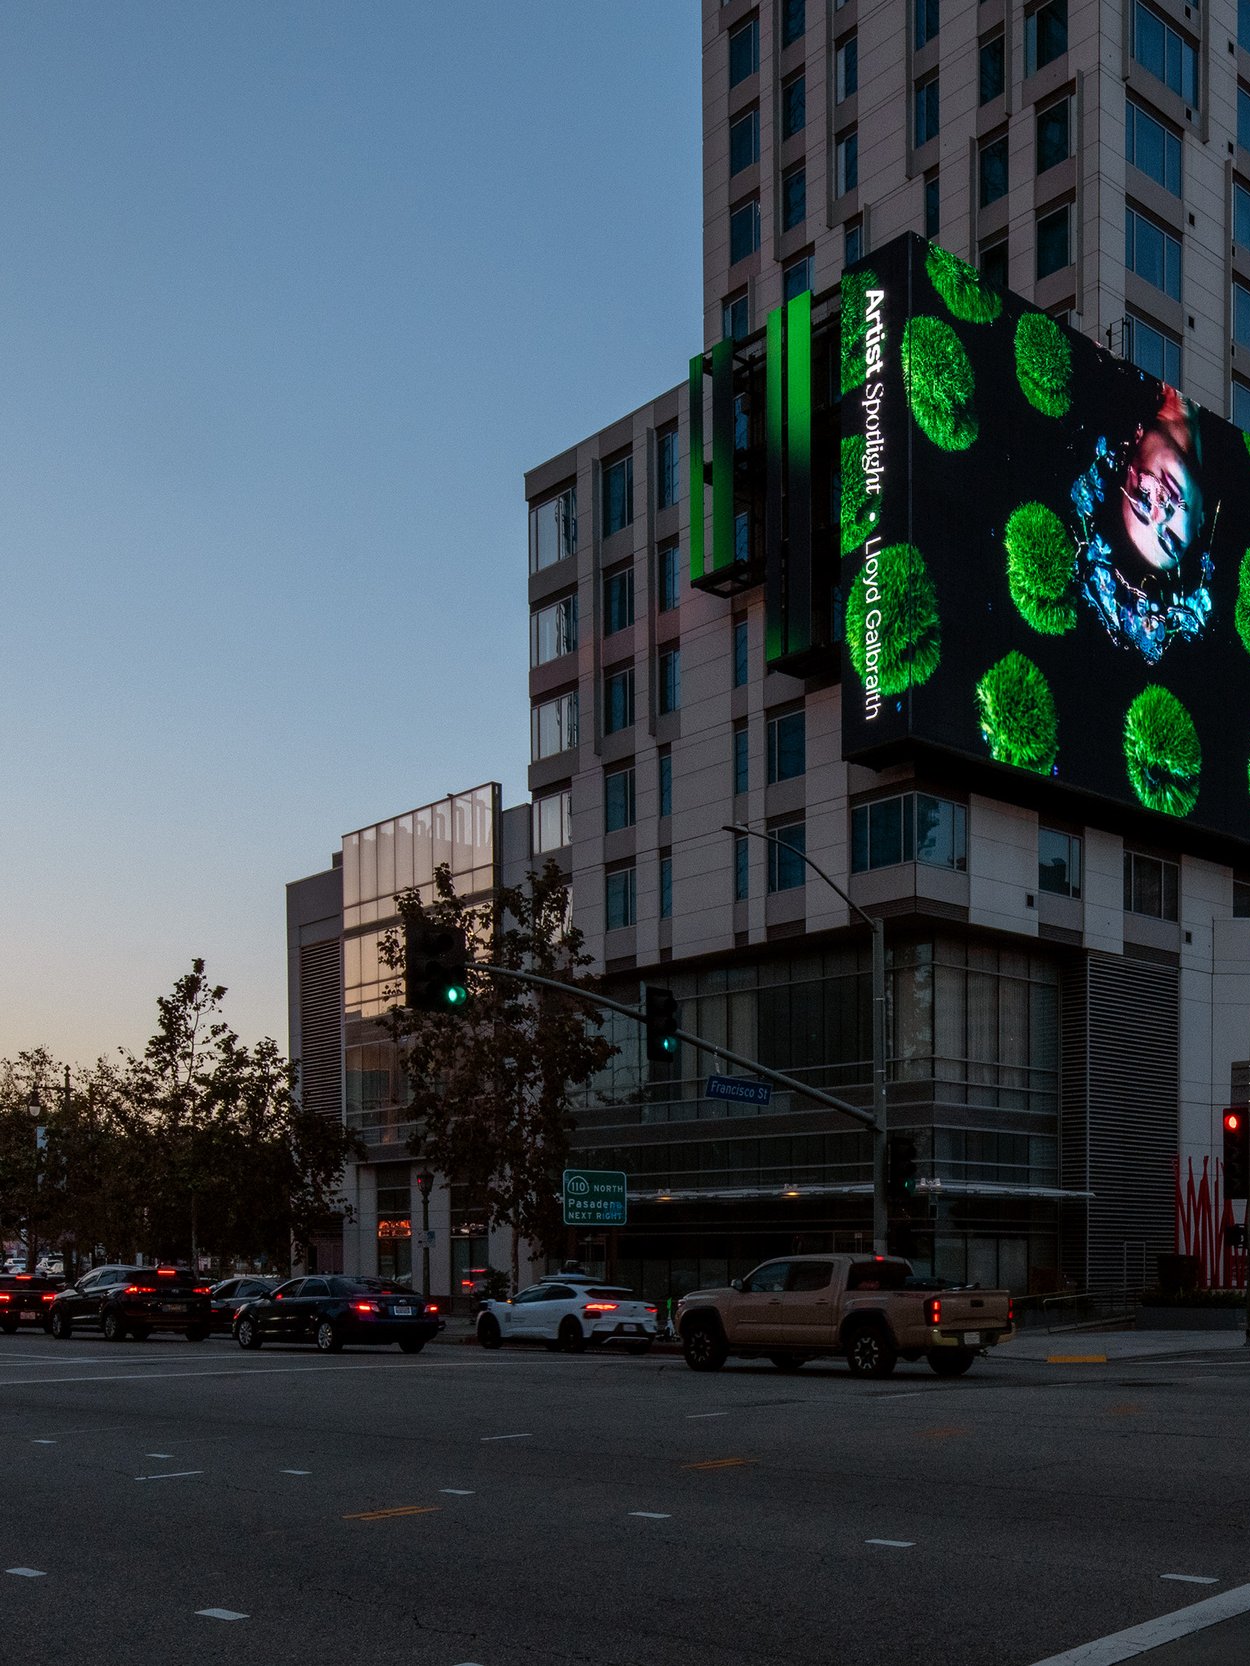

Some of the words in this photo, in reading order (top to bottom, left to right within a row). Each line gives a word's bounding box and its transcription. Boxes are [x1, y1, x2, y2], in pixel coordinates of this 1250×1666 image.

[865, 289, 885, 379] Artist
[861, 382, 885, 496] Spotlight
[863, 536, 883, 604] Lloyd
[864, 609, 883, 721] Galbraith
[710, 1080, 755, 1098] Francisco
[757, 1087, 769, 1100] St
[571, 1182, 586, 1192] 110
[593, 1185, 624, 1193] NORTH
[568, 1198, 624, 1209] Pasadena
[568, 1211, 592, 1220] NEXT
[596, 1212, 623, 1220] RIGHT
